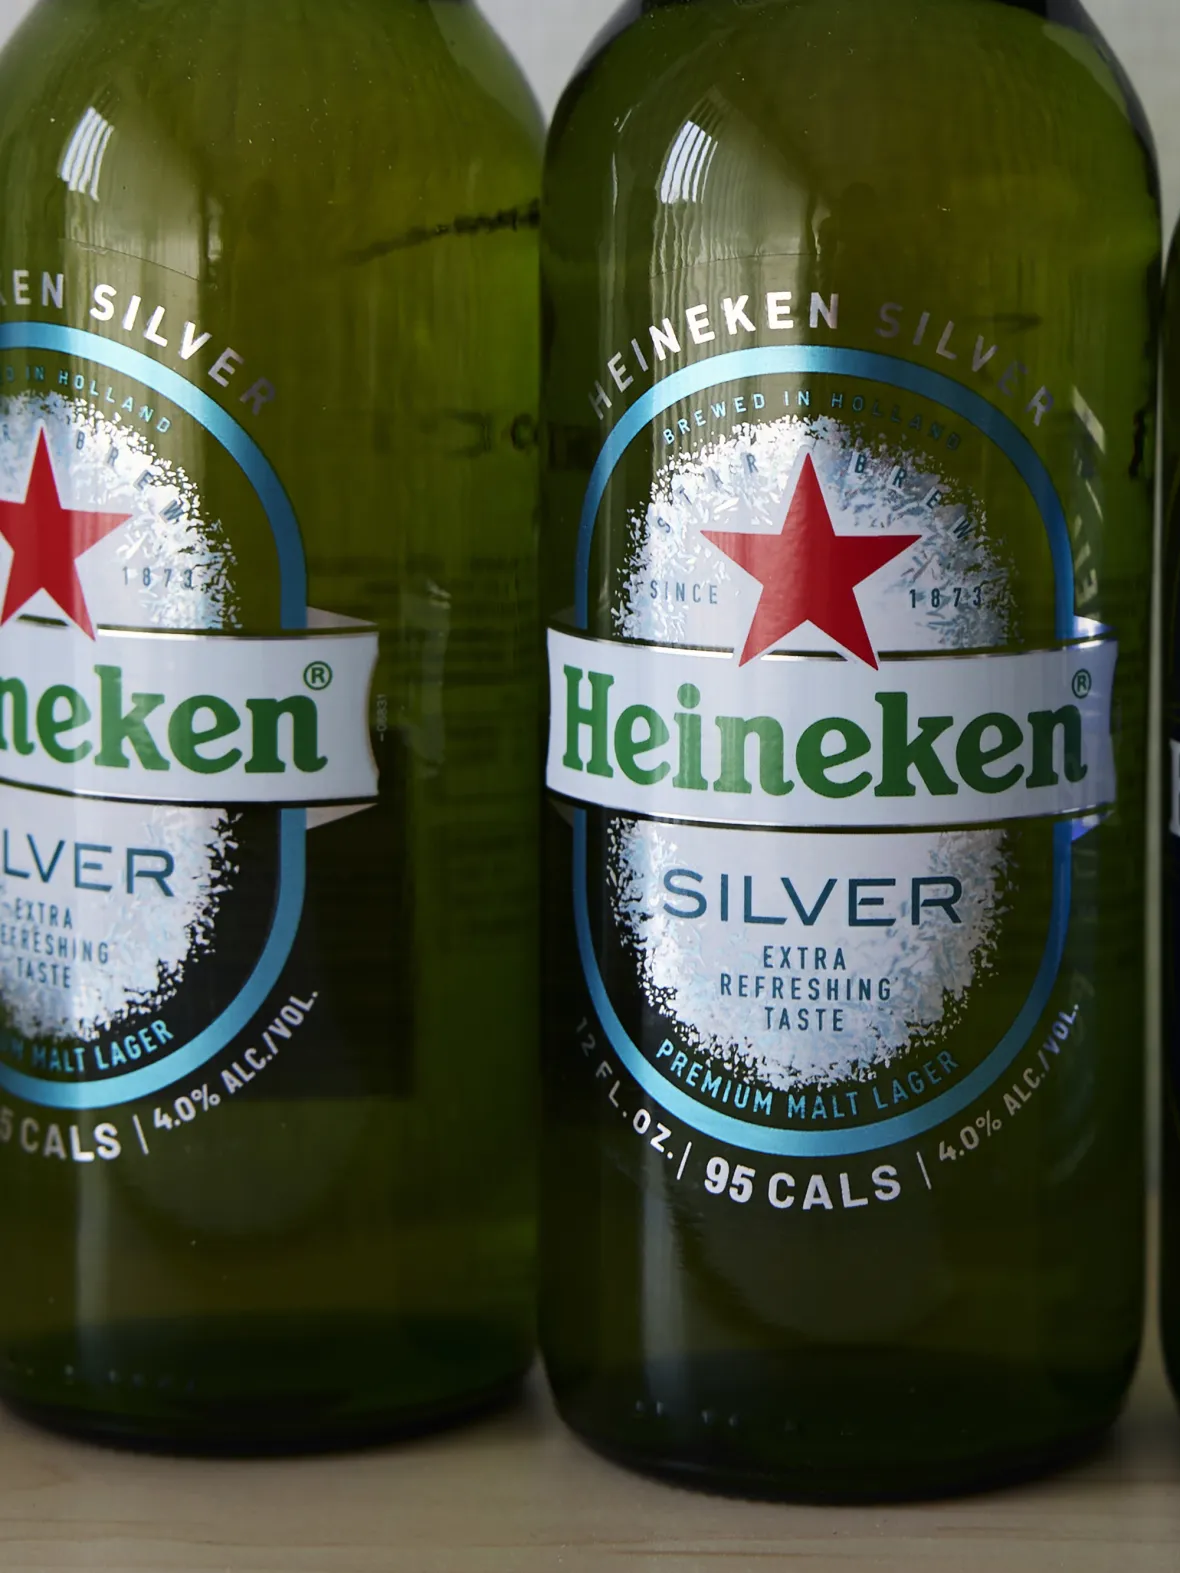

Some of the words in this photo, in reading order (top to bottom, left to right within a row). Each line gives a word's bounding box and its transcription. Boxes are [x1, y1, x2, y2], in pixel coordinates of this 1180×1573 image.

[90, 283, 276, 416] SILVER
[587, 291, 839, 420] HEINEKEN
[876, 302, 1054, 426] SILVER
[26, 366, 45, 381] IN
[58, 370, 171, 433] HOLLAND
[662, 392, 765, 445] BREWED
[783, 390, 811, 407] IN
[831, 392, 961, 451] HOLLAND
[657, 452, 759, 533] STAR
[854, 455, 973, 540] BREW
[123, 567, 193, 590] 1873
[649, 580, 719, 605] SINCE
[909, 586, 983, 609] 1873
[562, 664, 1089, 799] Heineken
[4, 828, 175, 898] LVER
[15, 897, 73, 930] EXTRA
[663, 868, 963, 927] SILVER
[17, 956, 71, 989] TASTE
[720, 974, 892, 1002] REFRESHING
[763, 945, 847, 970] EXTRA
[32, 1044, 85, 1074] MALT
[95, 1019, 174, 1071] LAGER
[764, 1006, 845, 1032] TASTE
[656, 1038, 774, 1117] PREMIUM
[787, 1091, 859, 1120] MALT
[874, 1049, 960, 1110] LAGER
[20, 1117, 121, 1163] CALS
[153, 1083, 221, 1130] 4.0%
[574, 1017, 597, 1058] 12
[632, 1108, 675, 1160] OZ.
[704, 1155, 756, 1203] 95
[768, 1164, 902, 1211] CALS
[938, 1109, 1003, 1162] 4.0%
